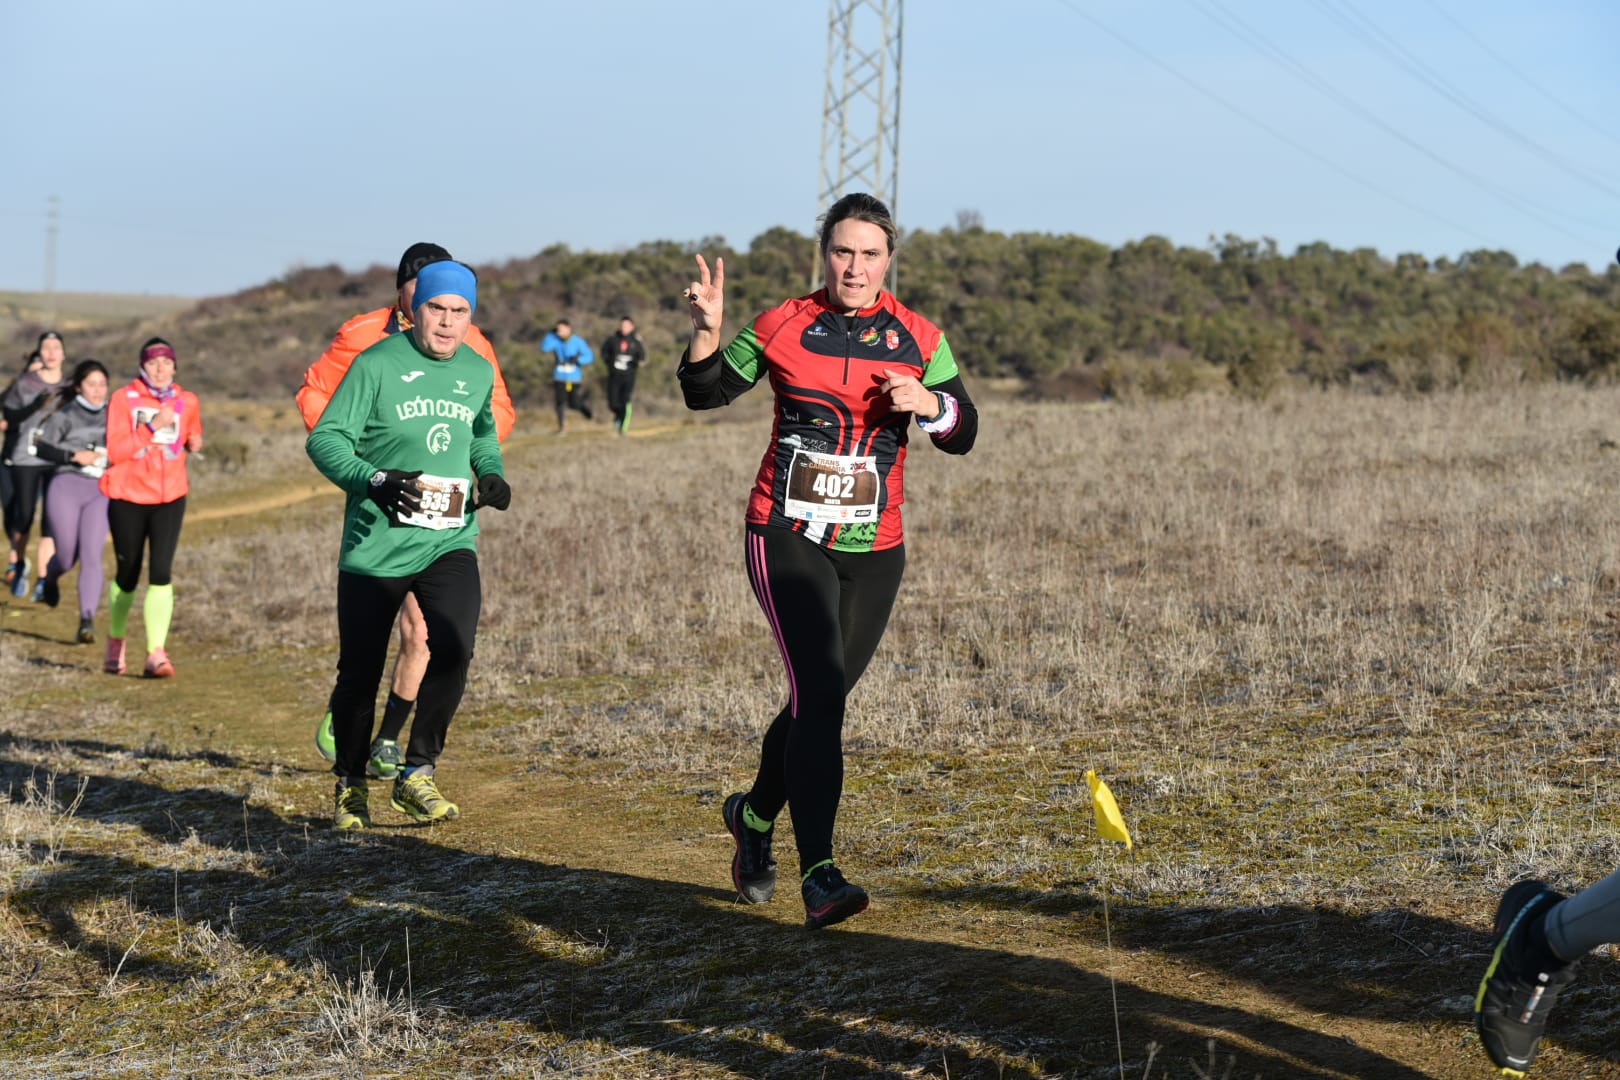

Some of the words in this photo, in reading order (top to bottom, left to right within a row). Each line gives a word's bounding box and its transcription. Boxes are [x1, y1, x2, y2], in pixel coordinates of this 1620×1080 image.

[817, 458, 840, 467] TRANS
[812, 473, 855, 498] 402
[419, 490, 451, 512] 535
